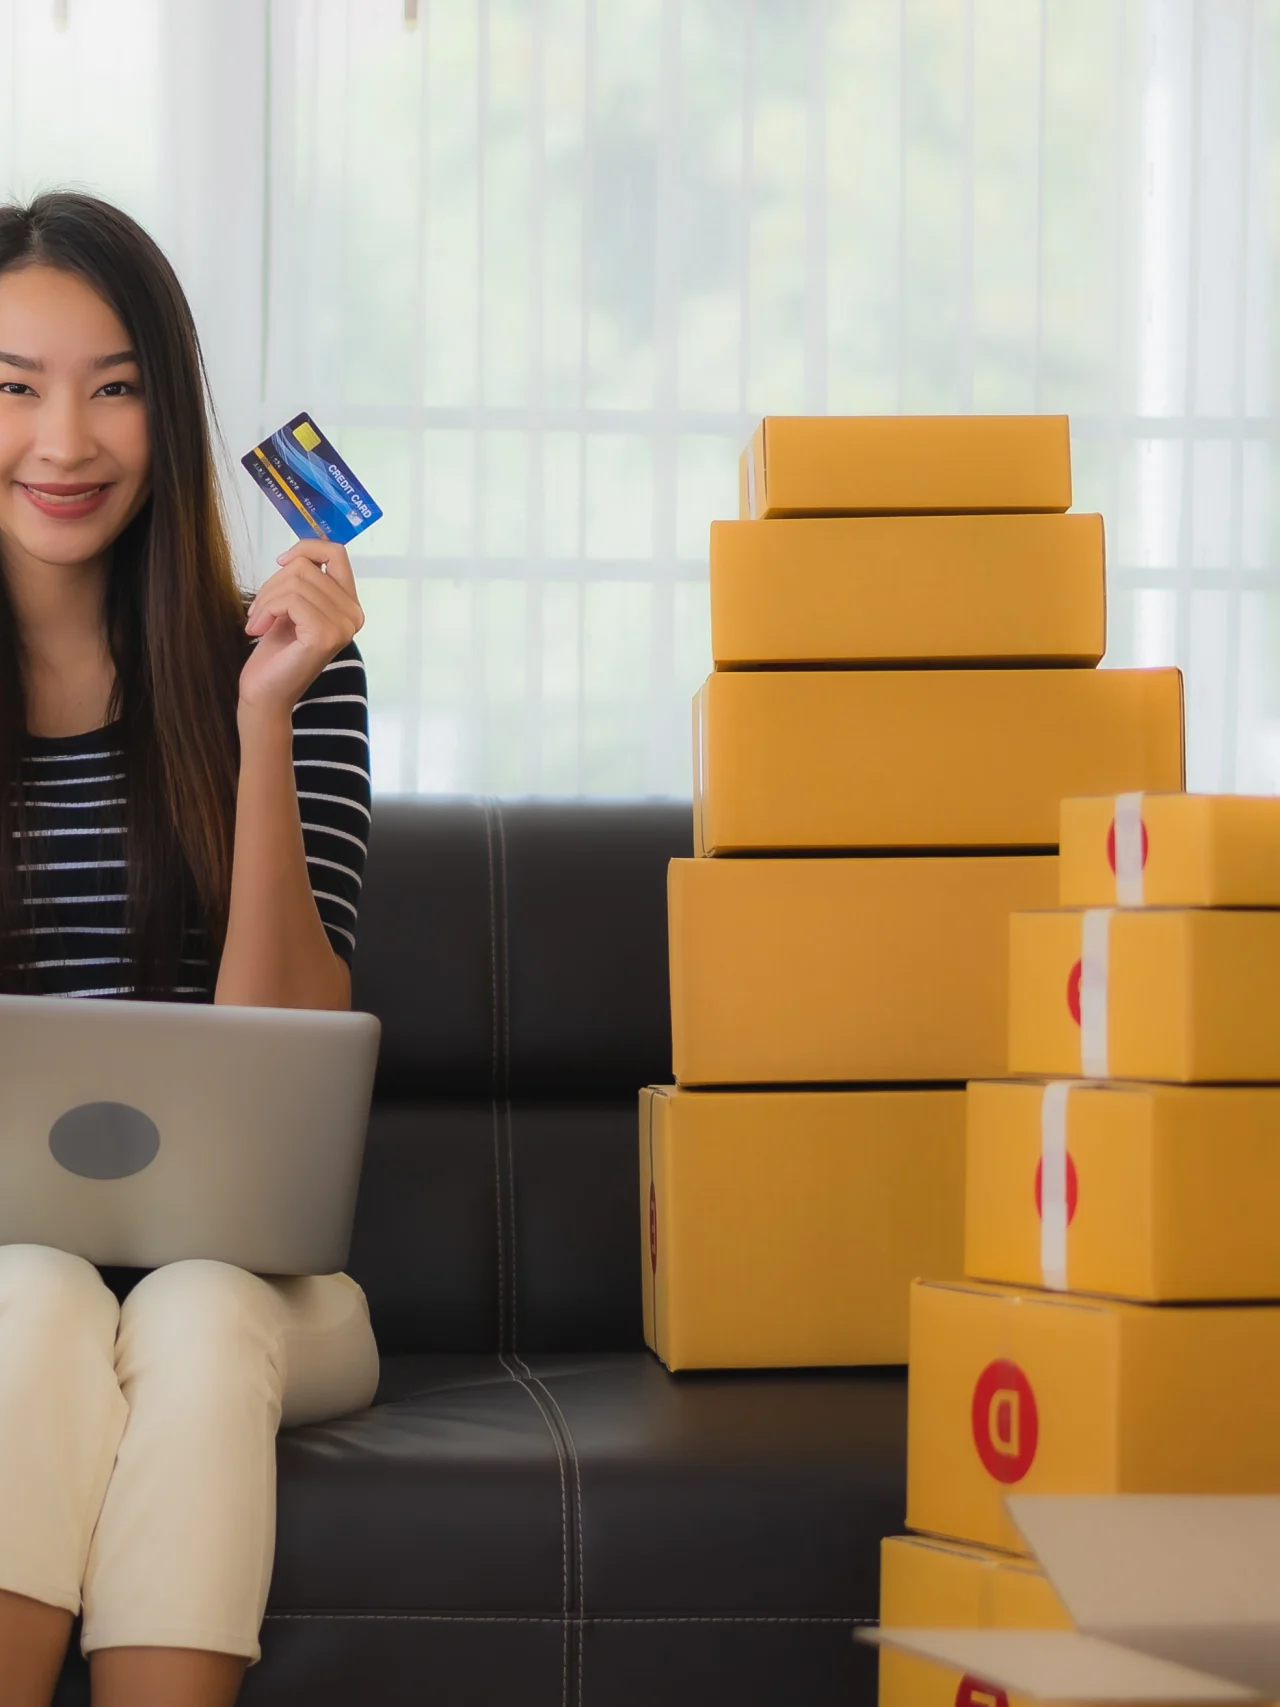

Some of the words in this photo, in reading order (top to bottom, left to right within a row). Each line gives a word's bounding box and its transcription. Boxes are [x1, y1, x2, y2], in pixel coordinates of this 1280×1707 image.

[328, 464, 355, 494] CREDIT
[351, 494, 372, 518] CARD
[988, 1388, 1020, 1457] D
